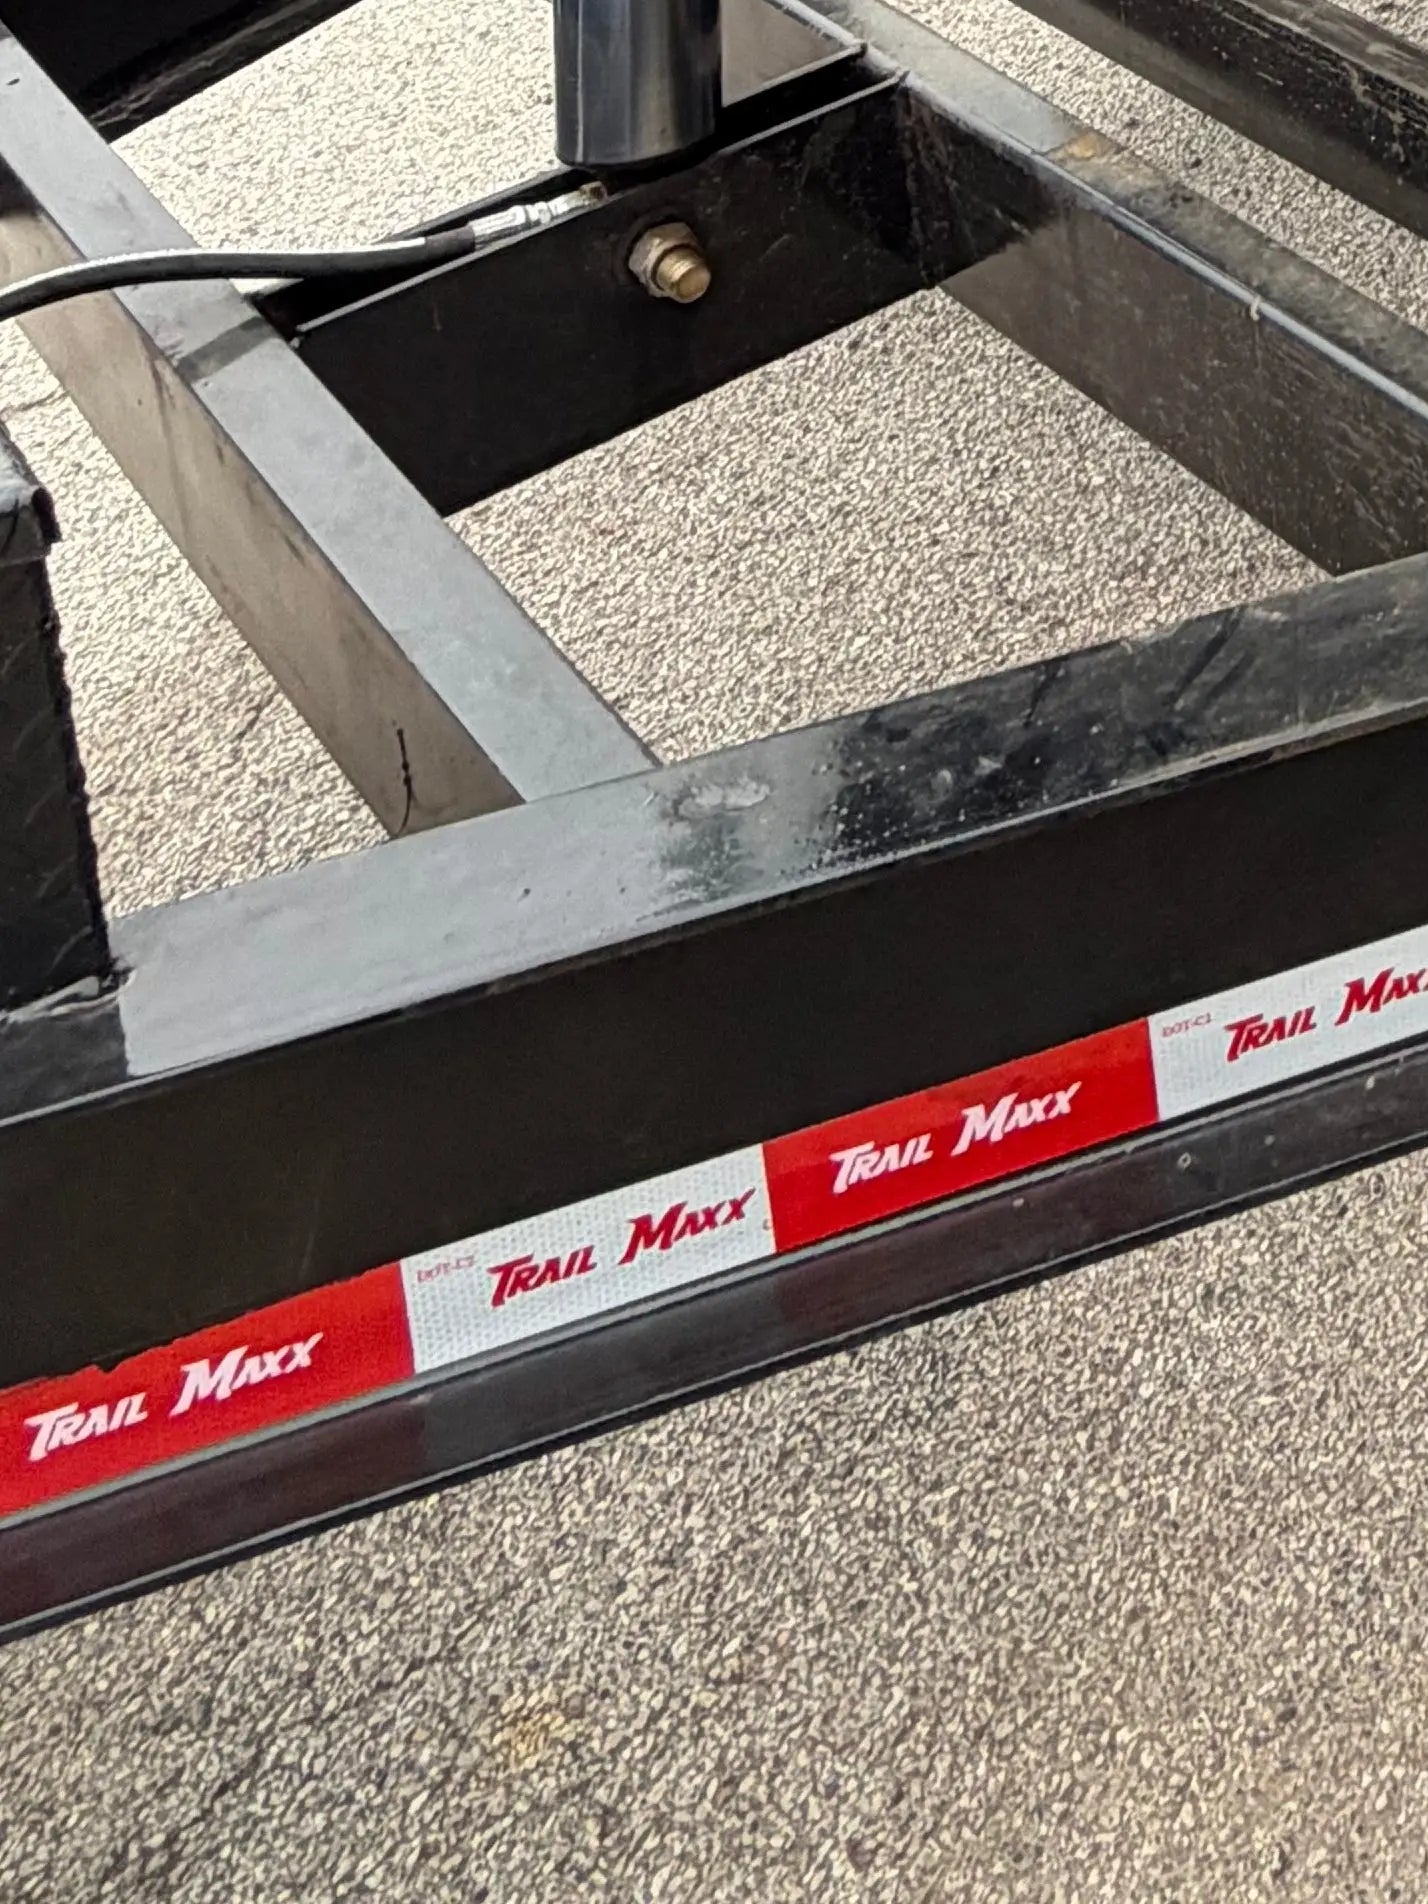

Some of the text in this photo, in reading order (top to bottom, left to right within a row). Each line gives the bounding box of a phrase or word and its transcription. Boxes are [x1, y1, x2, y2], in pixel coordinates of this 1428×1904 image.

[1223, 1005, 1317, 1063] TRAIL
[828, 1080, 1082, 1195] TRAIL MAXX
[487, 1187, 756, 1308] TRAIL MAXX
[23, 1332, 324, 1462] TRAIL MAXX
